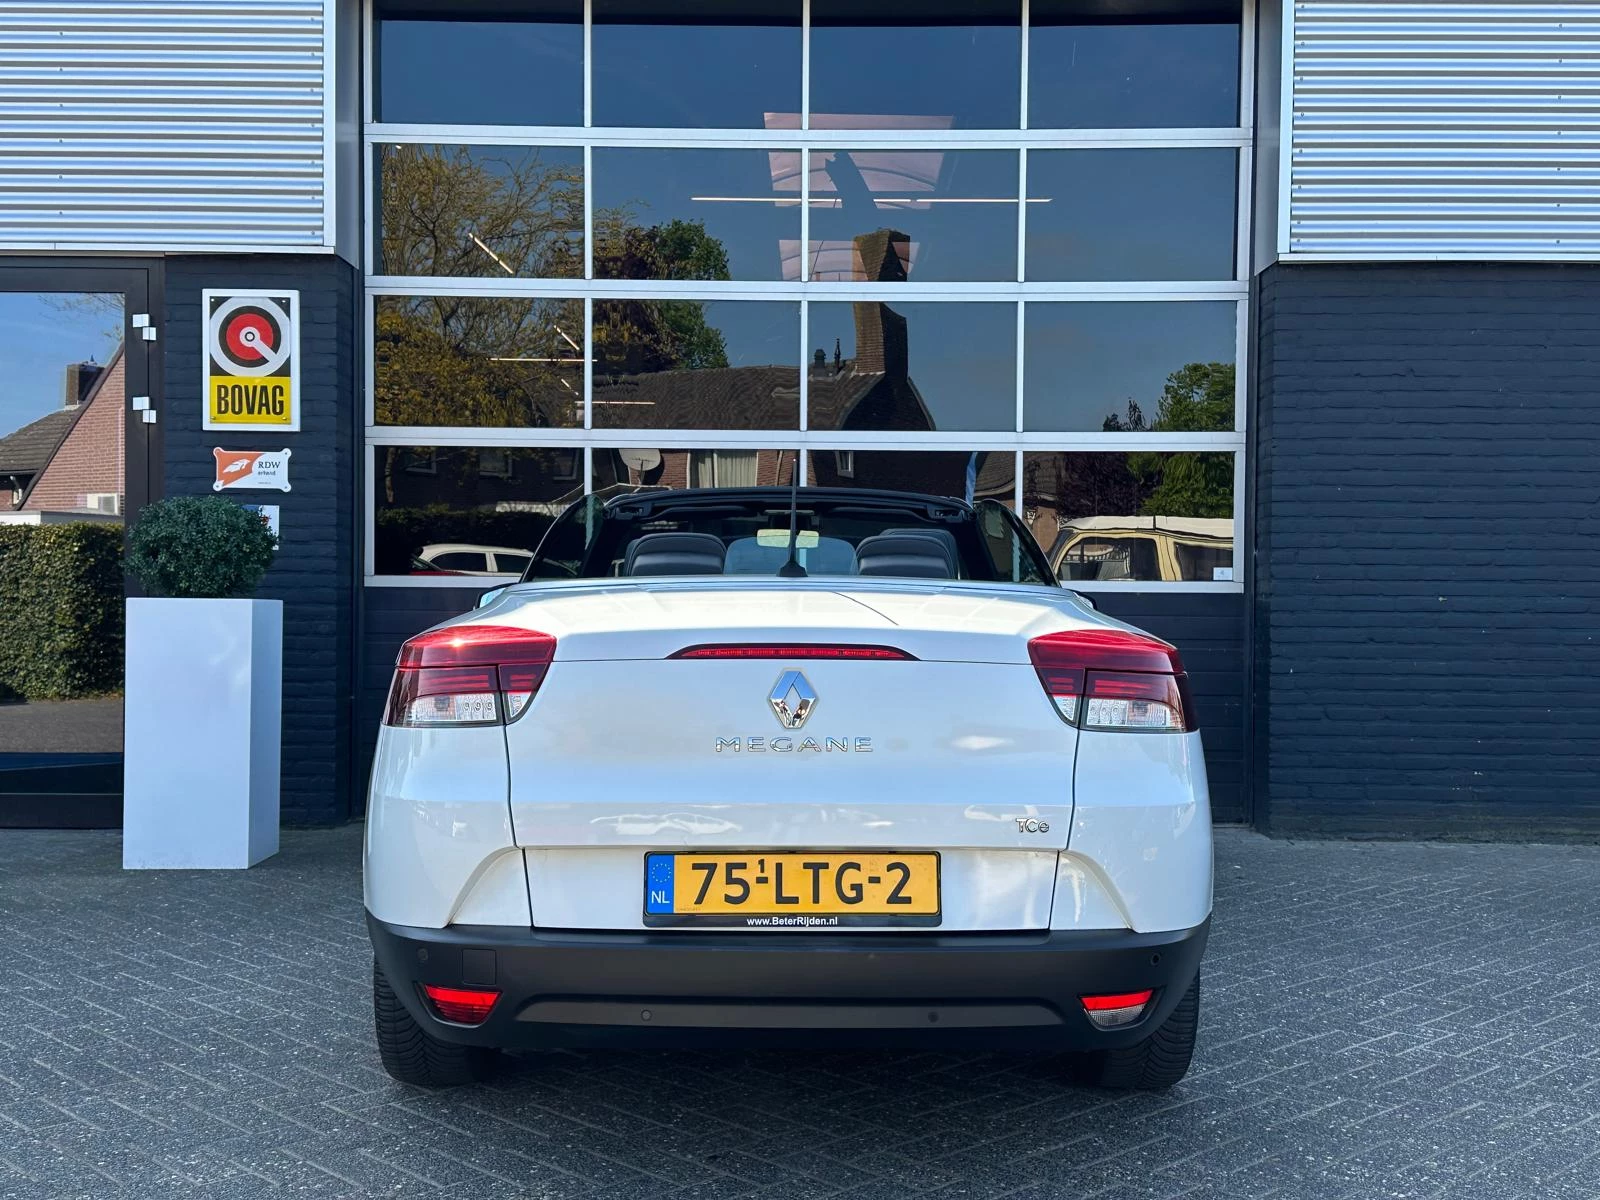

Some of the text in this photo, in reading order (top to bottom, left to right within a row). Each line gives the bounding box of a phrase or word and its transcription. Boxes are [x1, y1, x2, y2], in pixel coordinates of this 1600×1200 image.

[216, 384, 285, 415] BOVAG
[258, 461, 280, 469] RDW
[715, 736, 874, 752] MEGANE
[1016, 817, 1050, 833] TCe
[651, 890, 671, 904] NL
[746, 916, 838, 927] www.BeterRijden.nl
